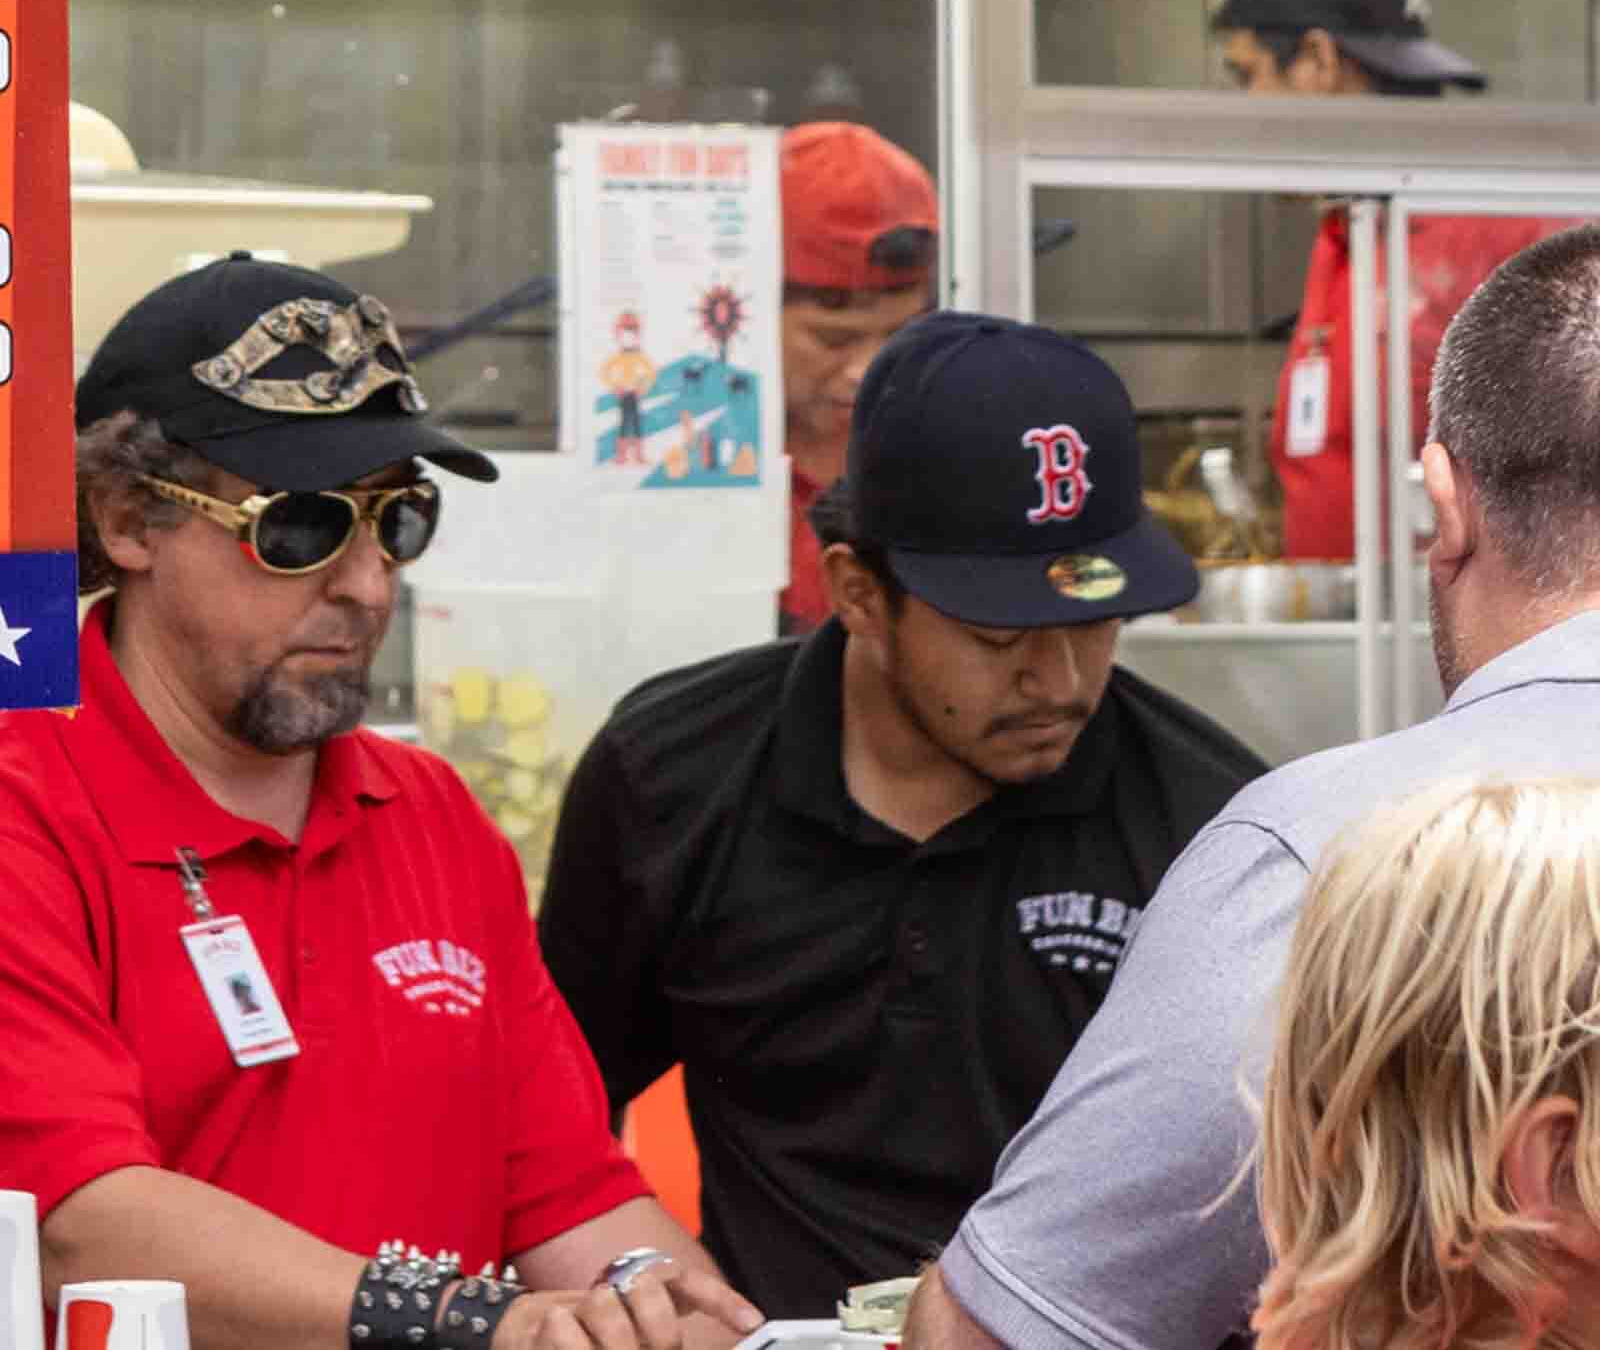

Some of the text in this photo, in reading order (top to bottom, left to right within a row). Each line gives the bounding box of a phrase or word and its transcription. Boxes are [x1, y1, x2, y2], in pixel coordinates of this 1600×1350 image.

[1021, 422, 1093, 526] B
[1015, 889, 1095, 934] FUN
[371, 938, 440, 988] FUN
